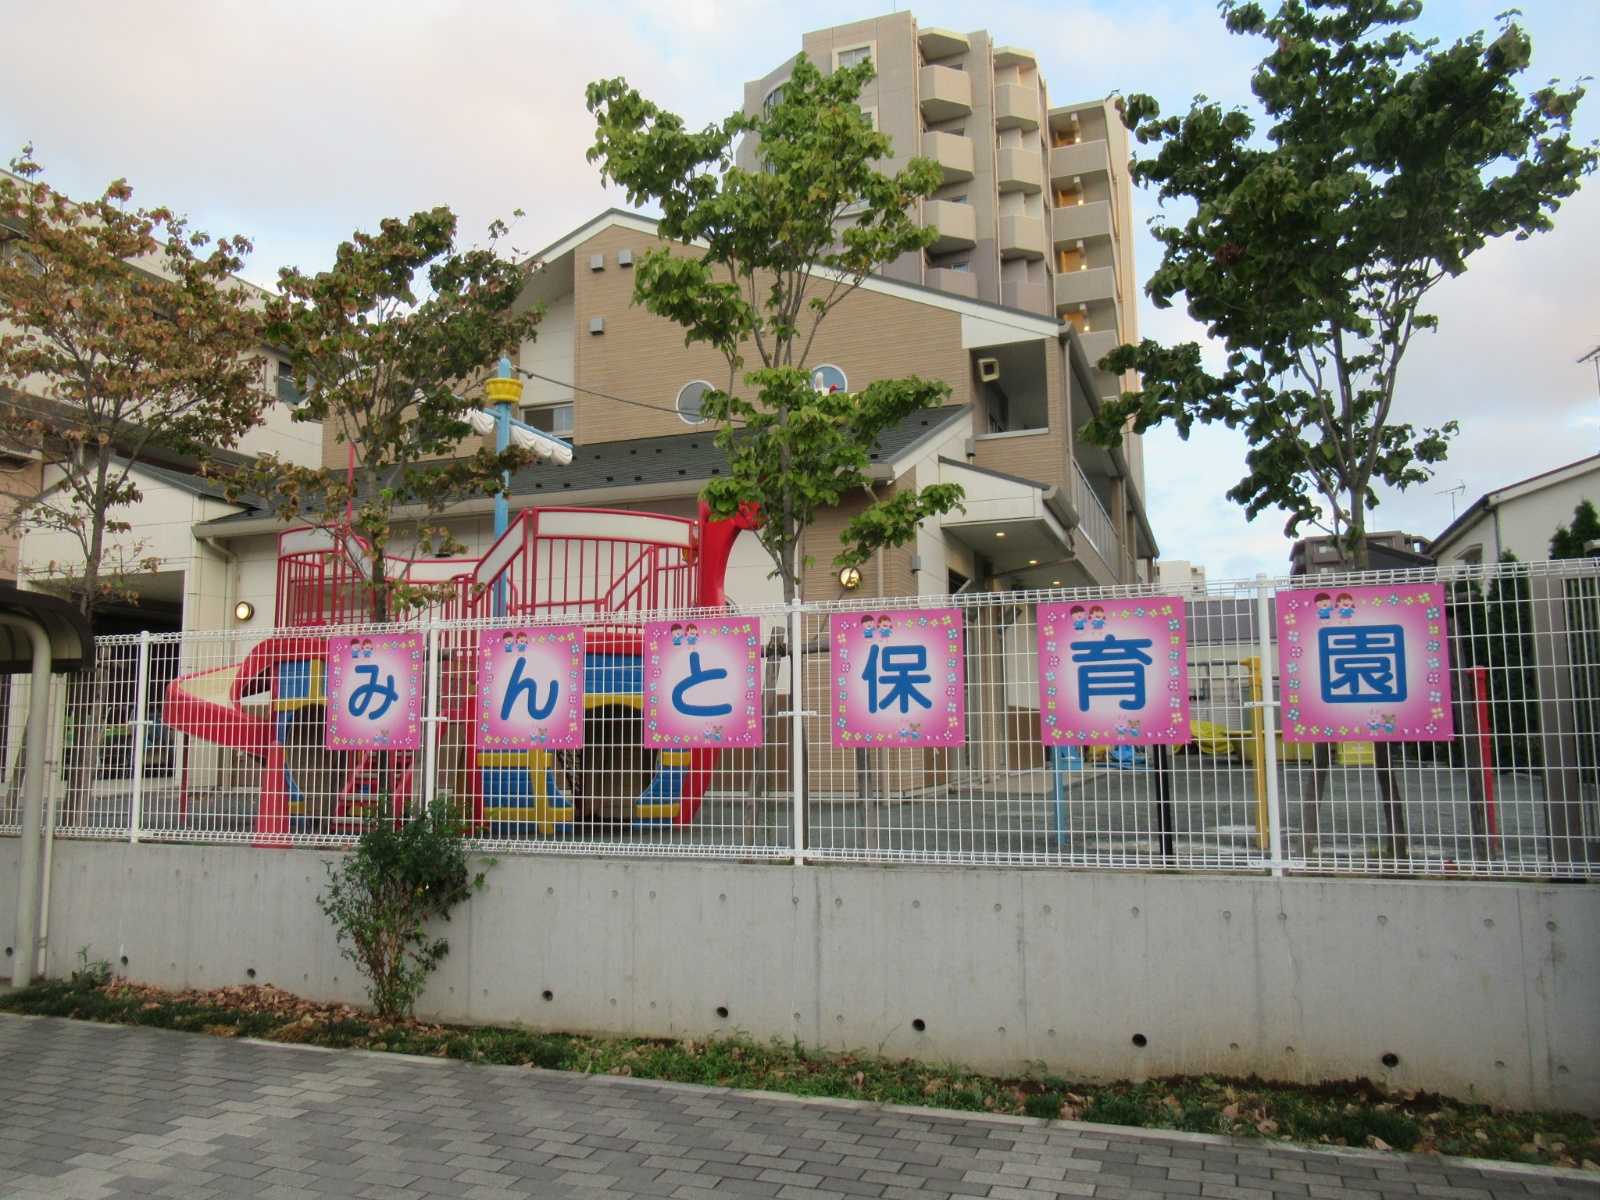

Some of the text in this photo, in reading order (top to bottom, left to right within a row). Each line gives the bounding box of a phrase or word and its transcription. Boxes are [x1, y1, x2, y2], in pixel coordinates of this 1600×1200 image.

[348, 623, 1408, 721] み ん と 保 育 園
